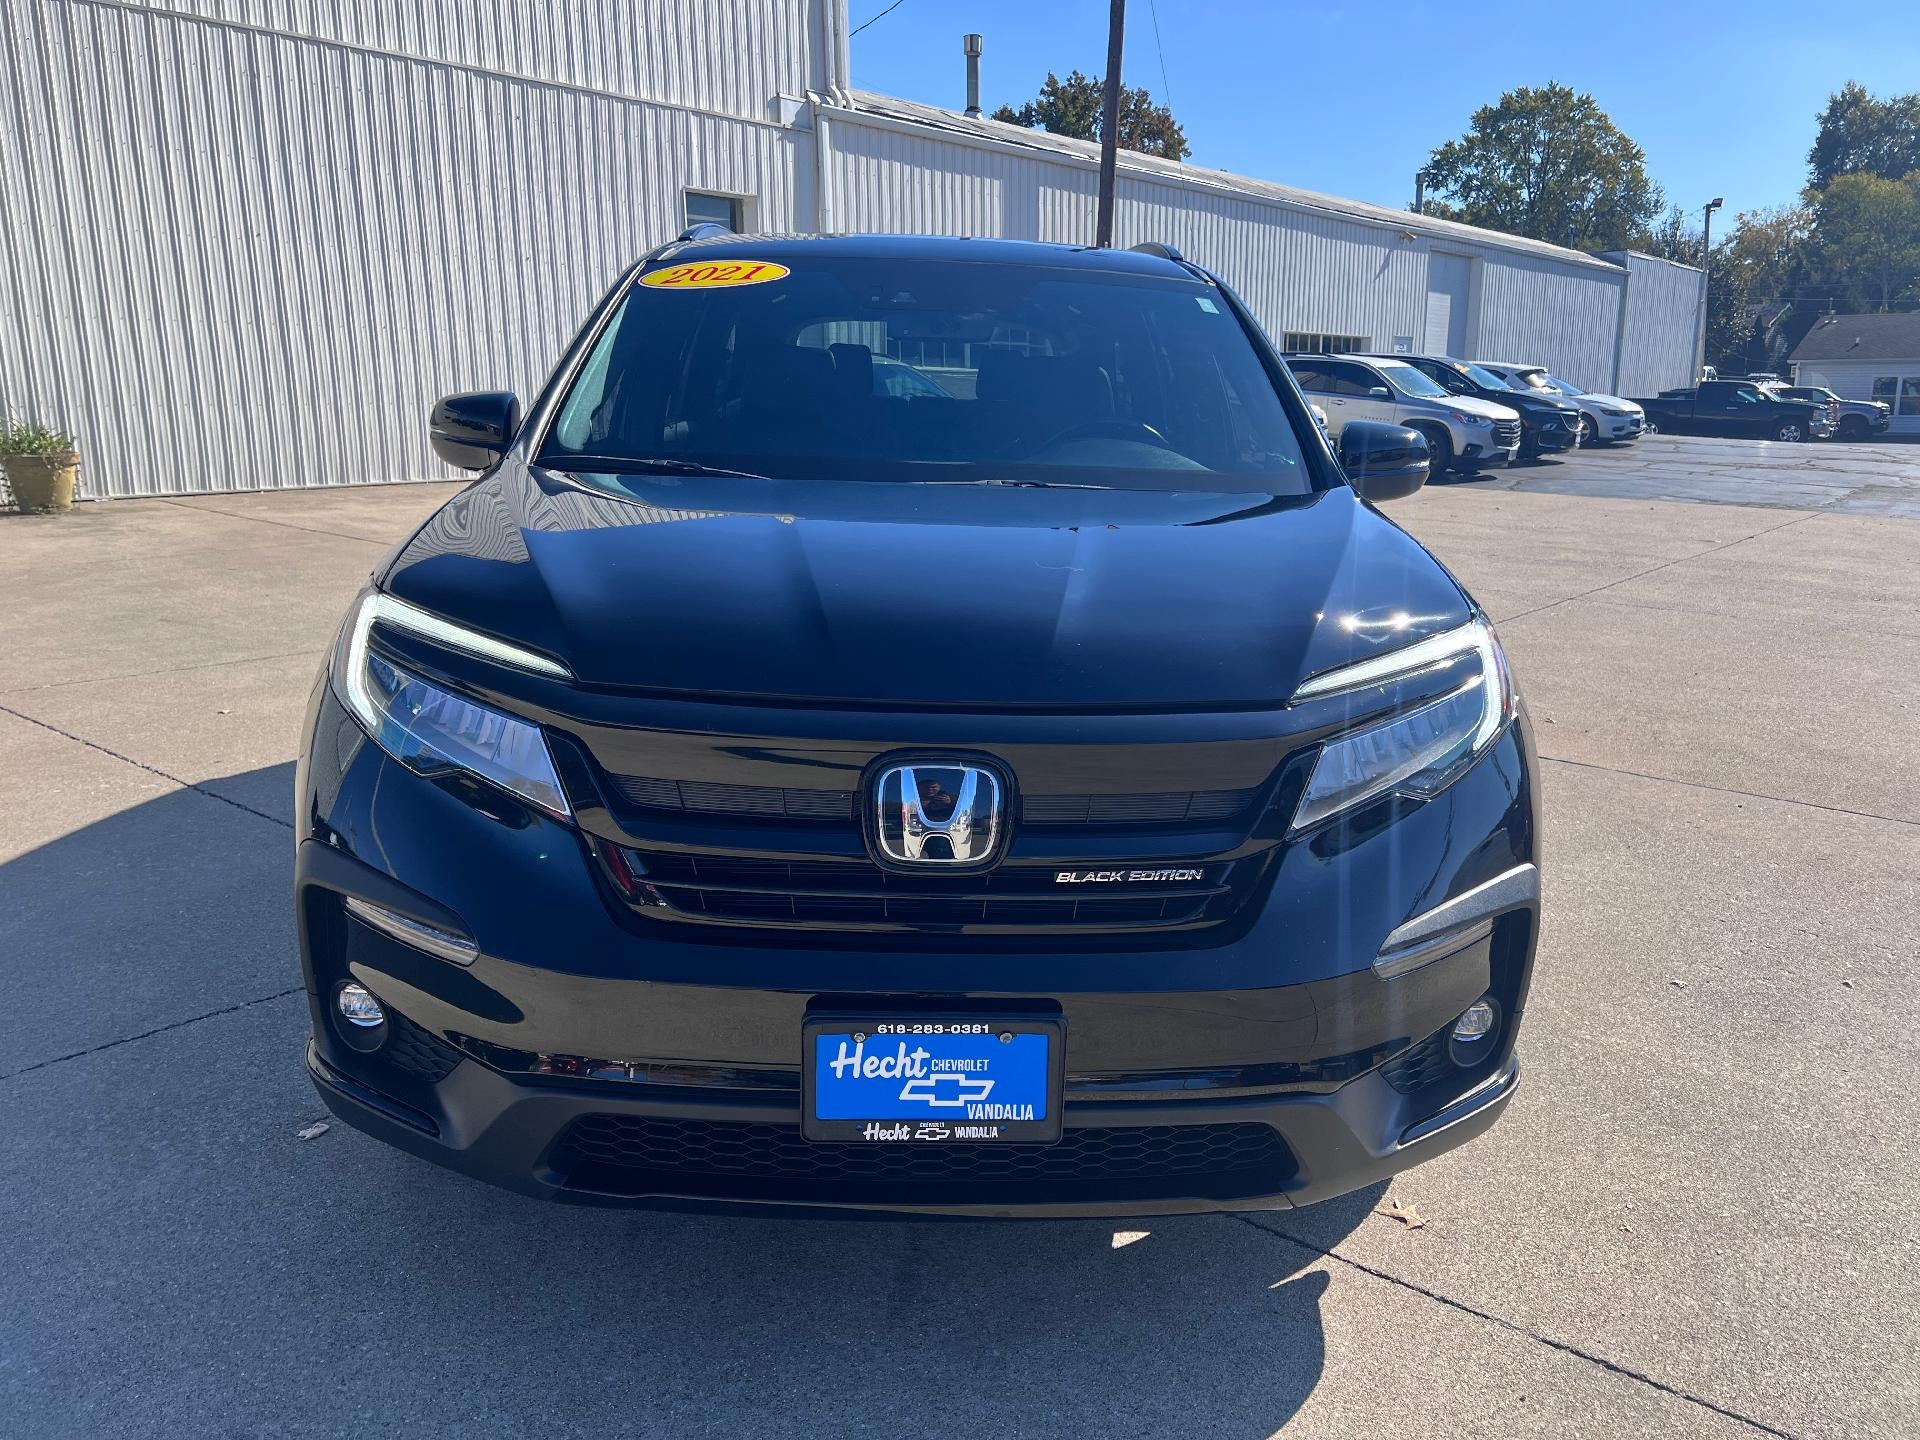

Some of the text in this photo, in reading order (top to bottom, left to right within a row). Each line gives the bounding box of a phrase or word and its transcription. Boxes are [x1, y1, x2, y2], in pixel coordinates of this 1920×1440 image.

[660, 265, 767, 284] 2021
[1055, 869, 1205, 883] BLACK EDITION
[877, 1024, 989, 1034] 618-283-0381
[830, 1041, 989, 1079] Hecht CHEVROLET
[967, 1103, 1034, 1121] VANDALIA
[862, 1122, 998, 1140] Hecht VANDALIA
